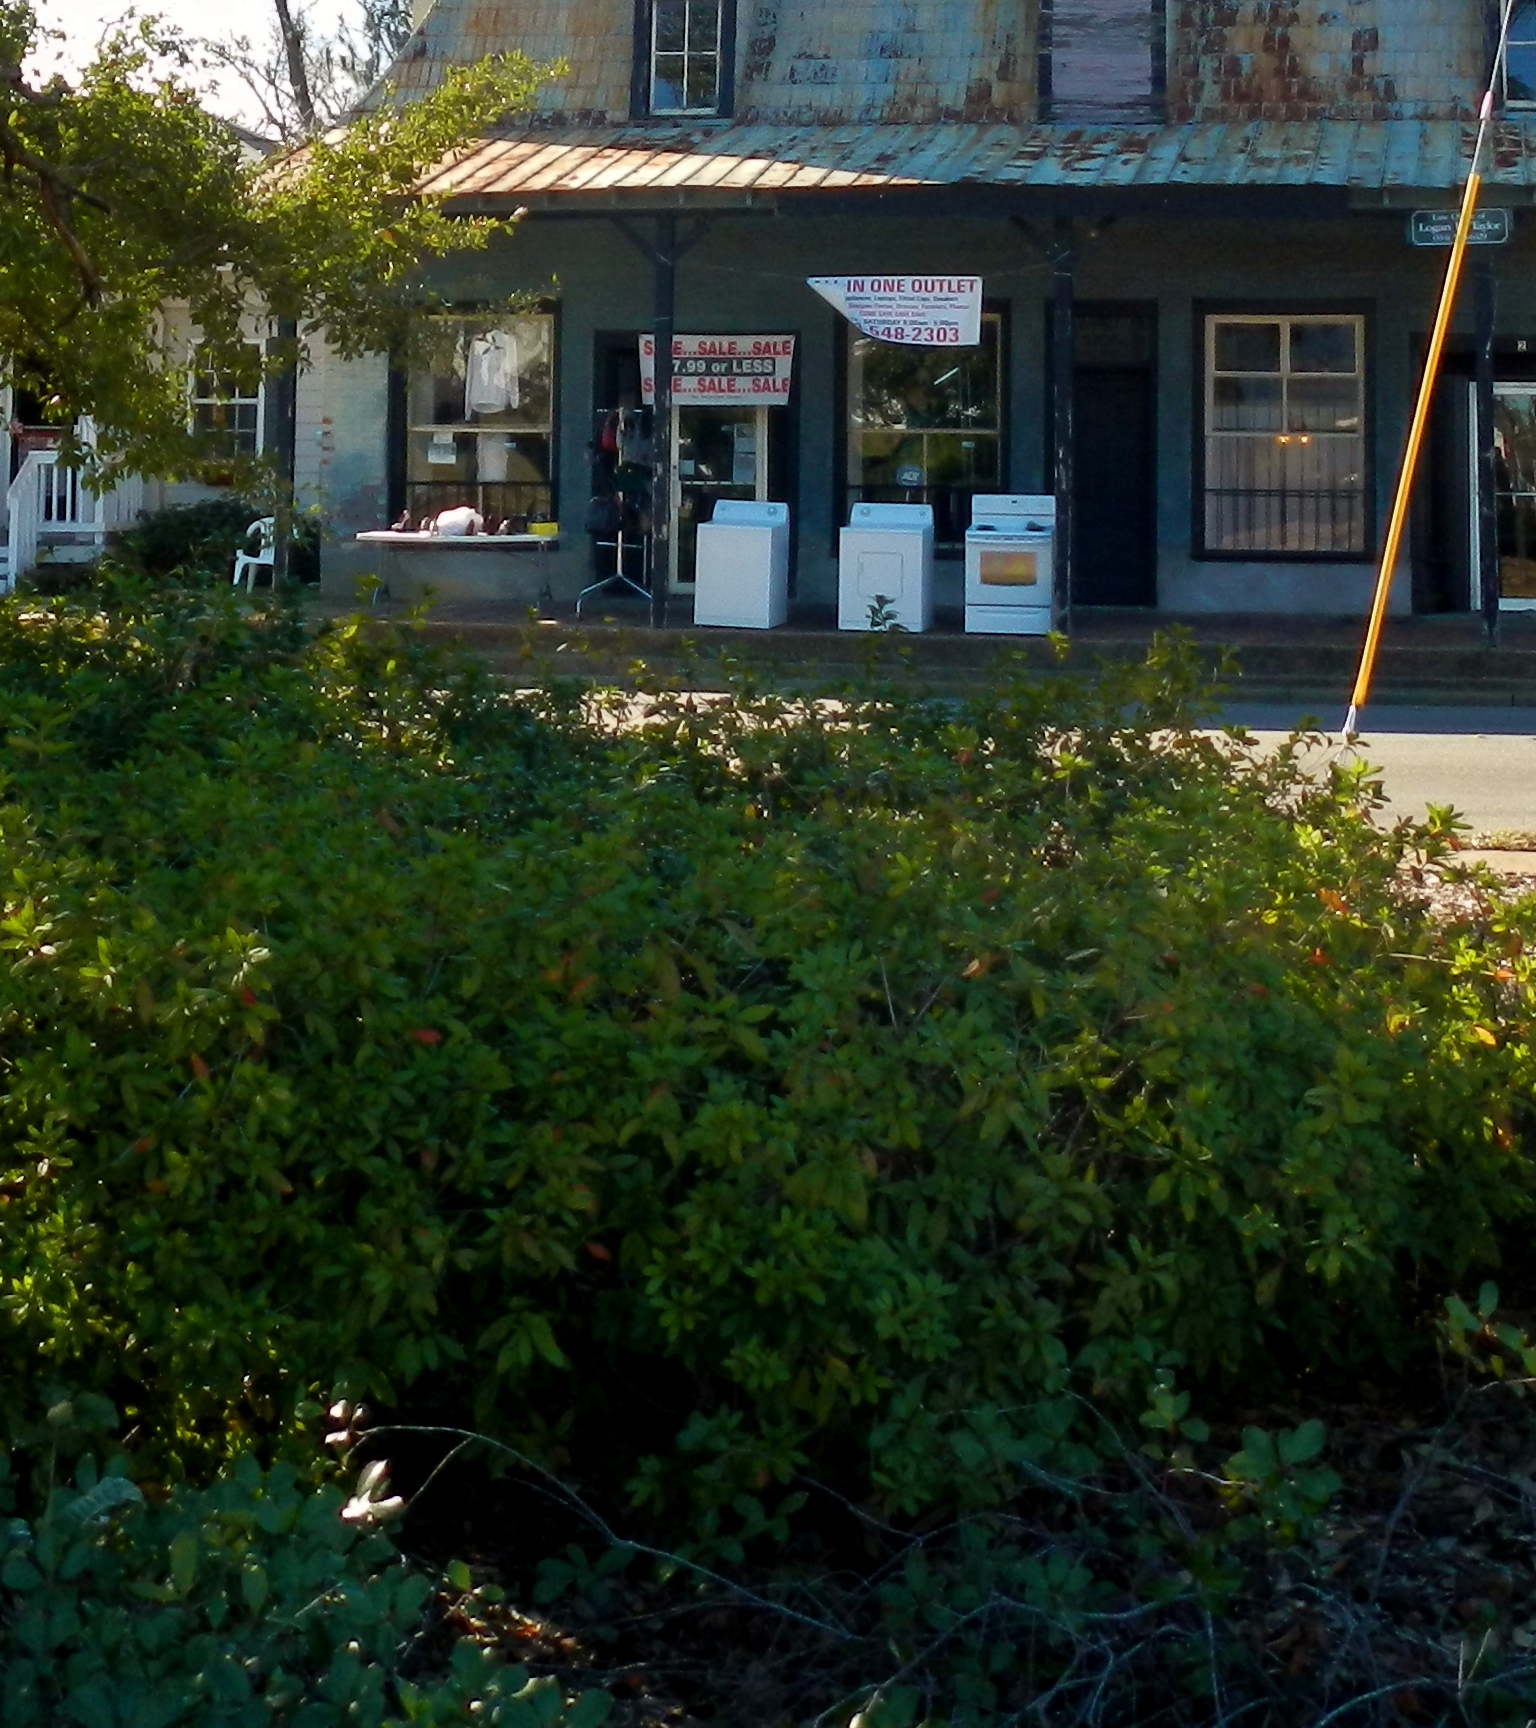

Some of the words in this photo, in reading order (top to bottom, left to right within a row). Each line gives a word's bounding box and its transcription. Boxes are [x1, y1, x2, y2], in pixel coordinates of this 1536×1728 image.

[1418, 222, 1452, 233] Logan
[847, 279, 864, 293] IN
[870, 278, 906, 293] ONE
[911, 278, 978, 293] OUTLET
[672, 359, 706, 373] 7.99
[711, 361, 728, 373] or
[732, 359, 773, 373] LESS
